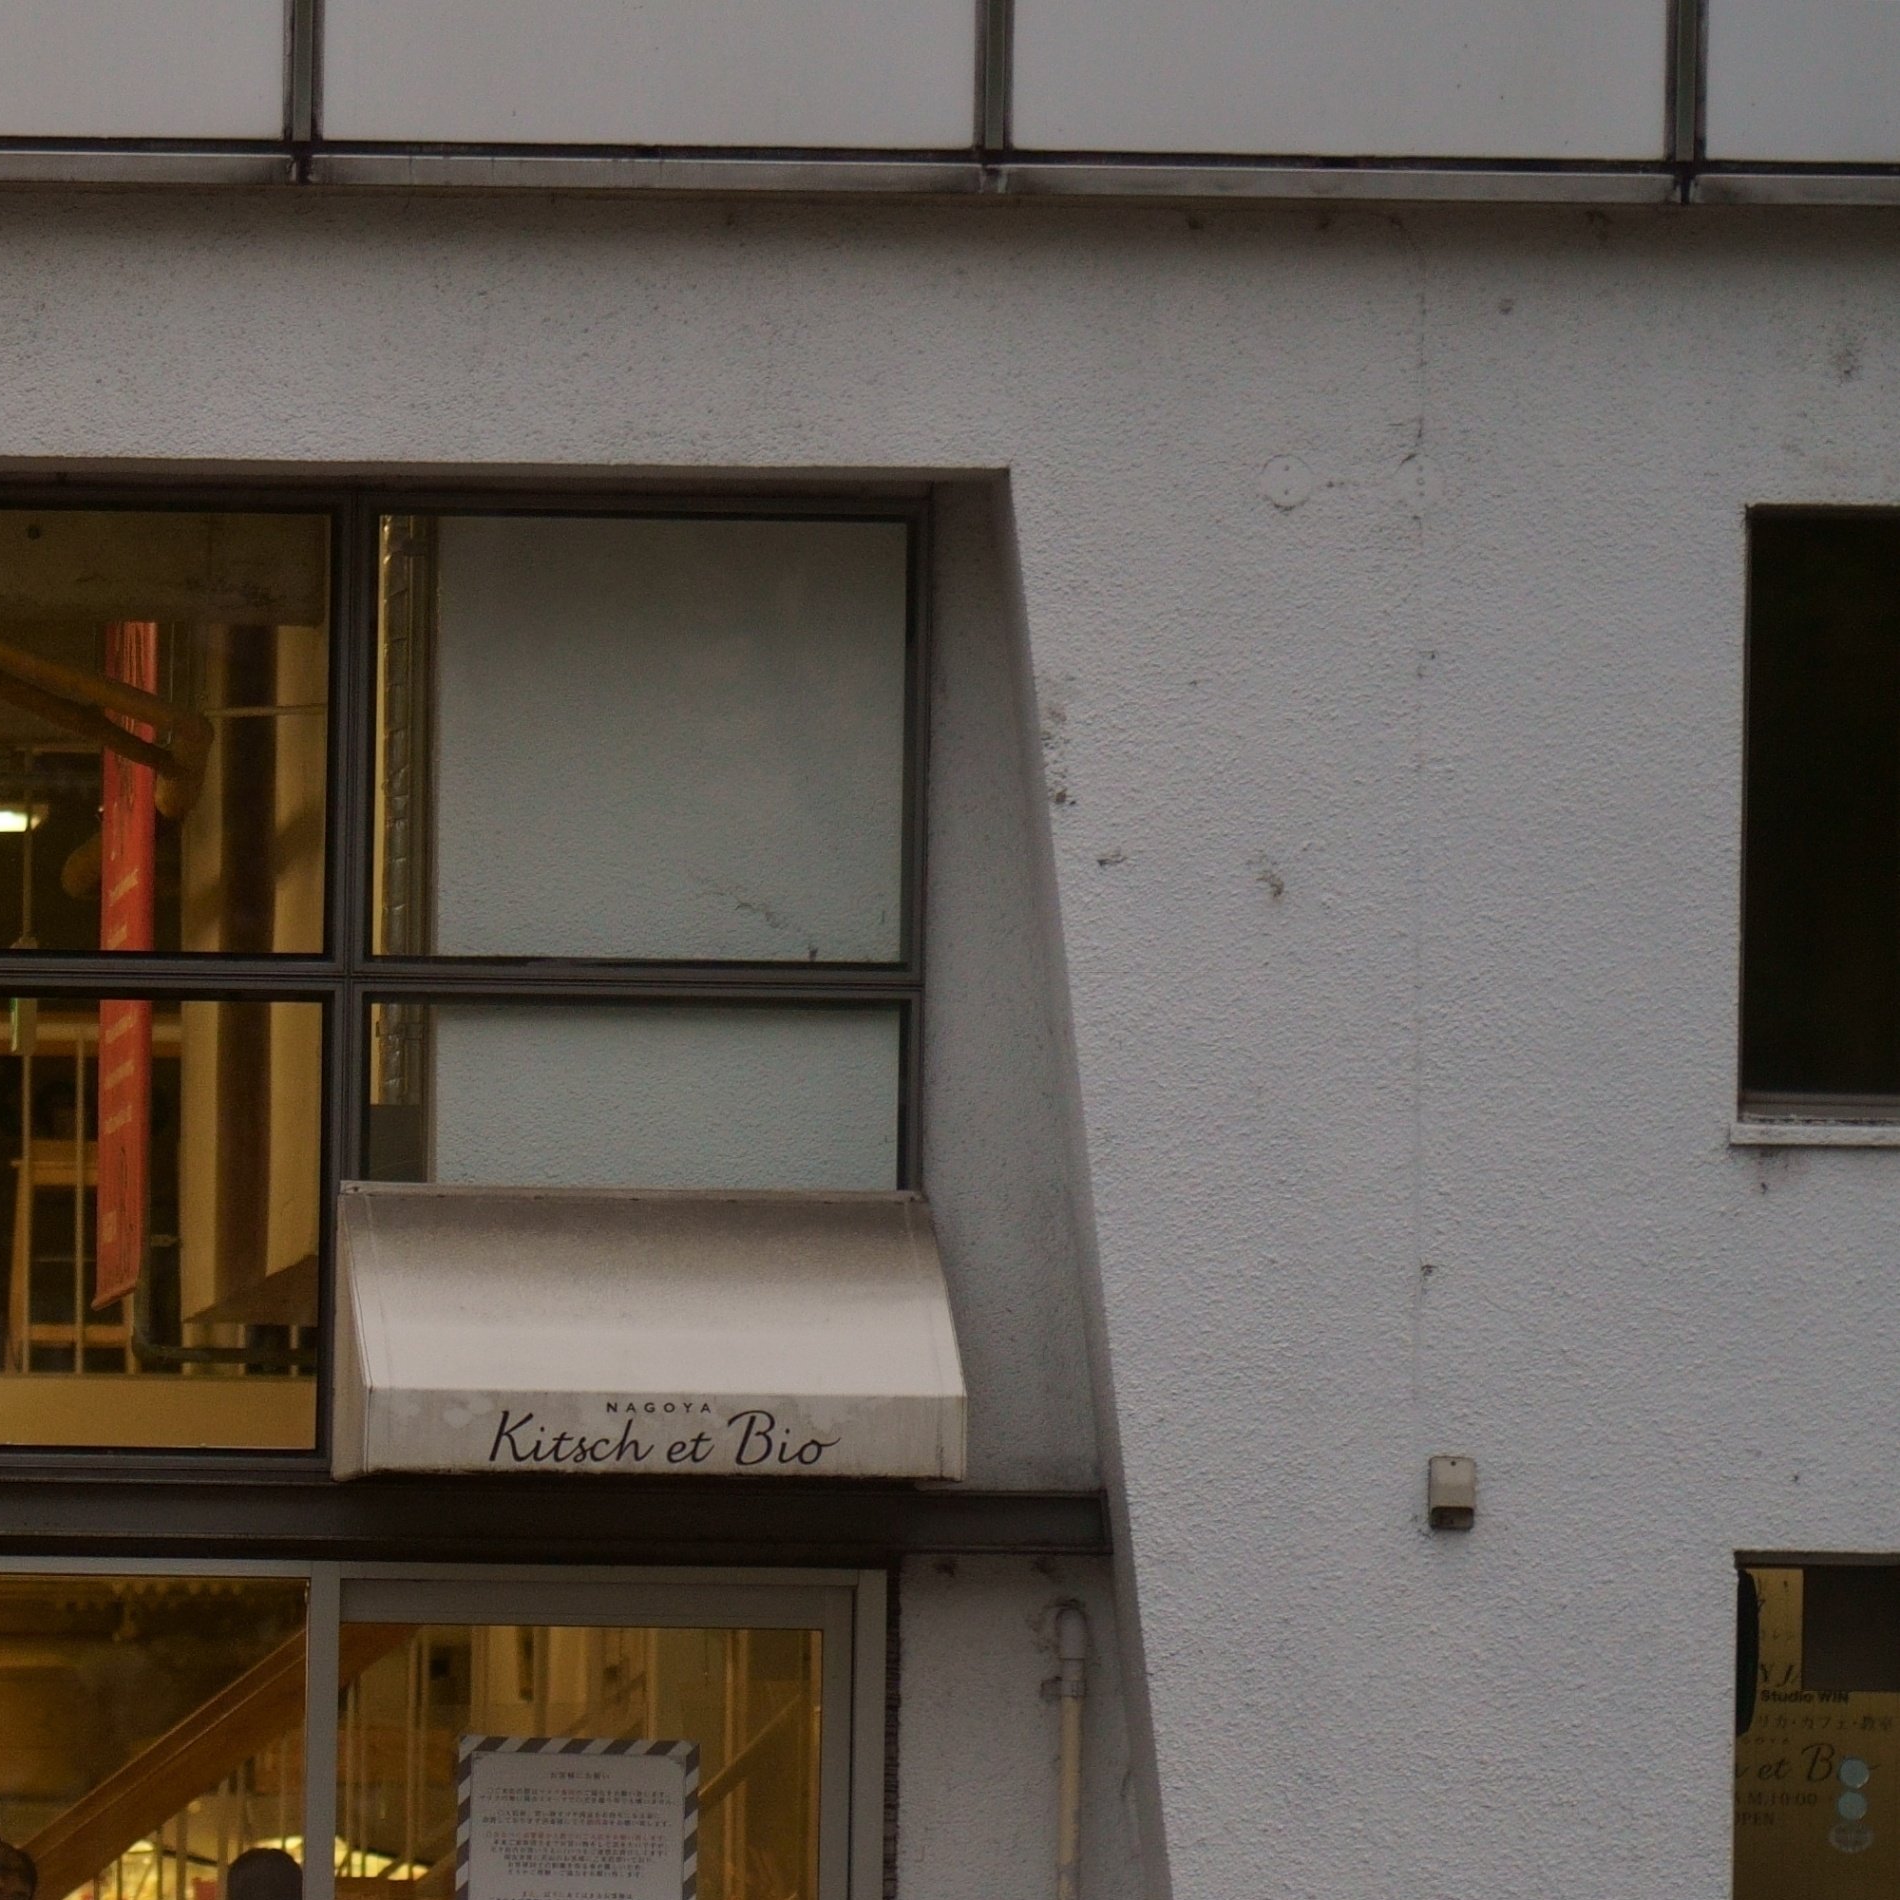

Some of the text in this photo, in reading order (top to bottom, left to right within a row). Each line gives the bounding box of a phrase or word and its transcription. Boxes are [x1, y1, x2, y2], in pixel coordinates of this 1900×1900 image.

[606, 1401, 712, 1414] NAGOYA
[489, 1410, 842, 1465] Kitsch et Bio
